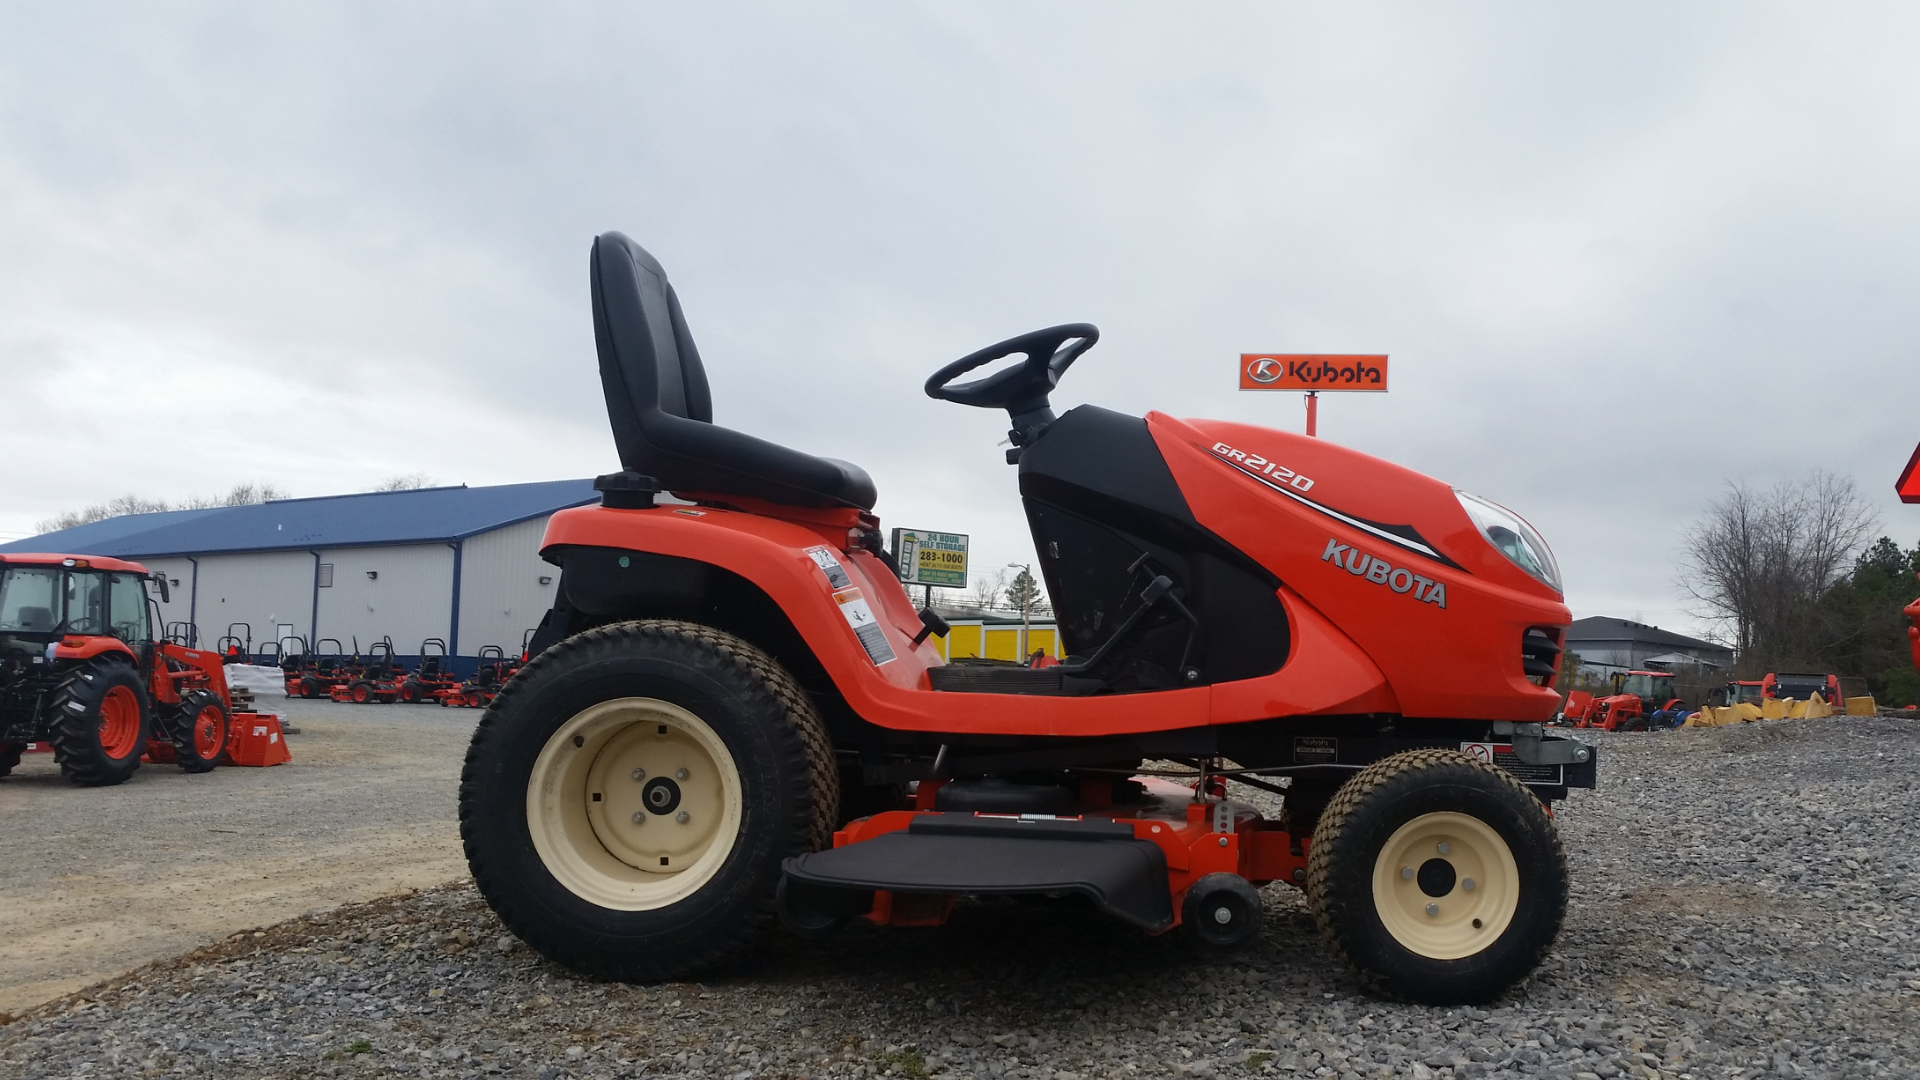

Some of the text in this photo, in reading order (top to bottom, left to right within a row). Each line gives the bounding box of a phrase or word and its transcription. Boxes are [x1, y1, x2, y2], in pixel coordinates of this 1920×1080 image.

[1289, 361, 1381, 383] Kubota
[1212, 442, 1315, 492] GR2120
[928, 533, 959, 544] 24 HOUR
[936, 542, 966, 552] STORAGE
[920, 551, 963, 563] 283-1000
[1321, 538, 1447, 609] KUBOTA
[1302, 738, 1329, 746] Kubota
